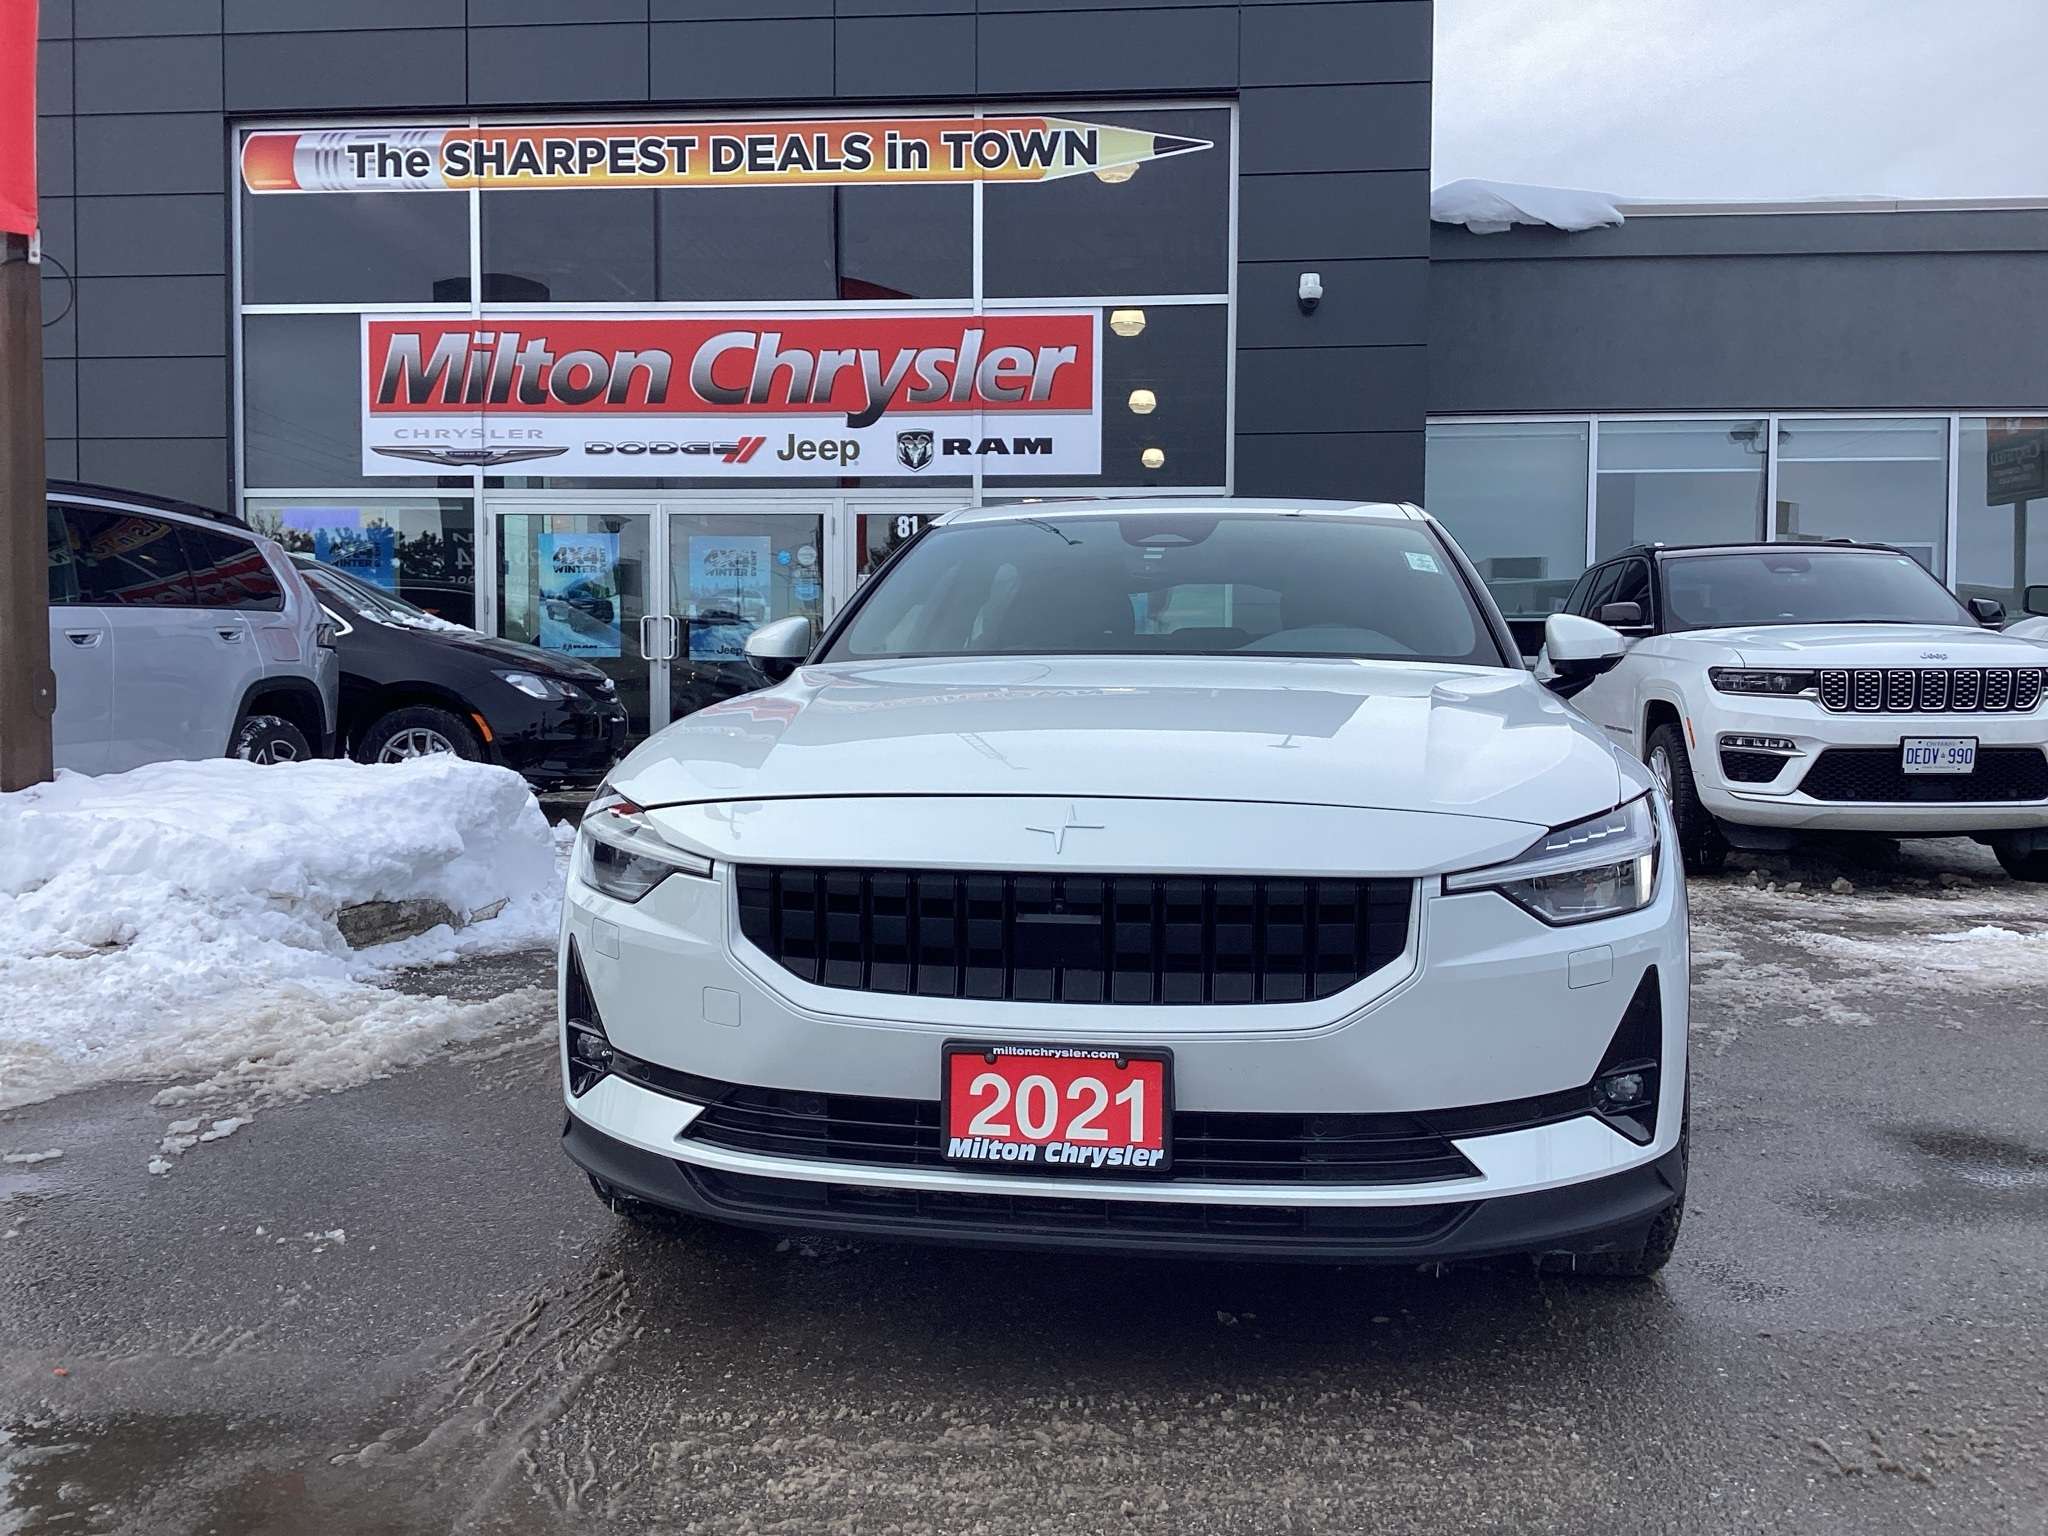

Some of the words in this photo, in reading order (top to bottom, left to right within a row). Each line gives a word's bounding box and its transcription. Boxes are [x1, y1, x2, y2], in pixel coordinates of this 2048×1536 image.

[347, 143, 431, 180] The
[442, 138, 697, 177] SHARPEST
[711, 133, 872, 174] DEALS
[885, 130, 929, 171] in
[943, 129, 1099, 169] TOWN
[375, 330, 673, 405] Milton
[689, 328, 1077, 429] Chrysler
[394, 428, 543, 440] CHRYSLER
[584, 441, 740, 456] DODGE
[776, 433, 860, 466] Jeep
[942, 437, 1053, 455] RAM
[897, 515, 919, 538] 81
[716, 645, 743, 657] Jeep
[1947, 748, 1973, 764] 990
[992, 1046, 1120, 1060] miltonchrysler.com
[967, 1072, 1145, 1143] 2021
[947, 1136, 1037, 1162] Milton
[1043, 1140, 1165, 1169] Chrysler
